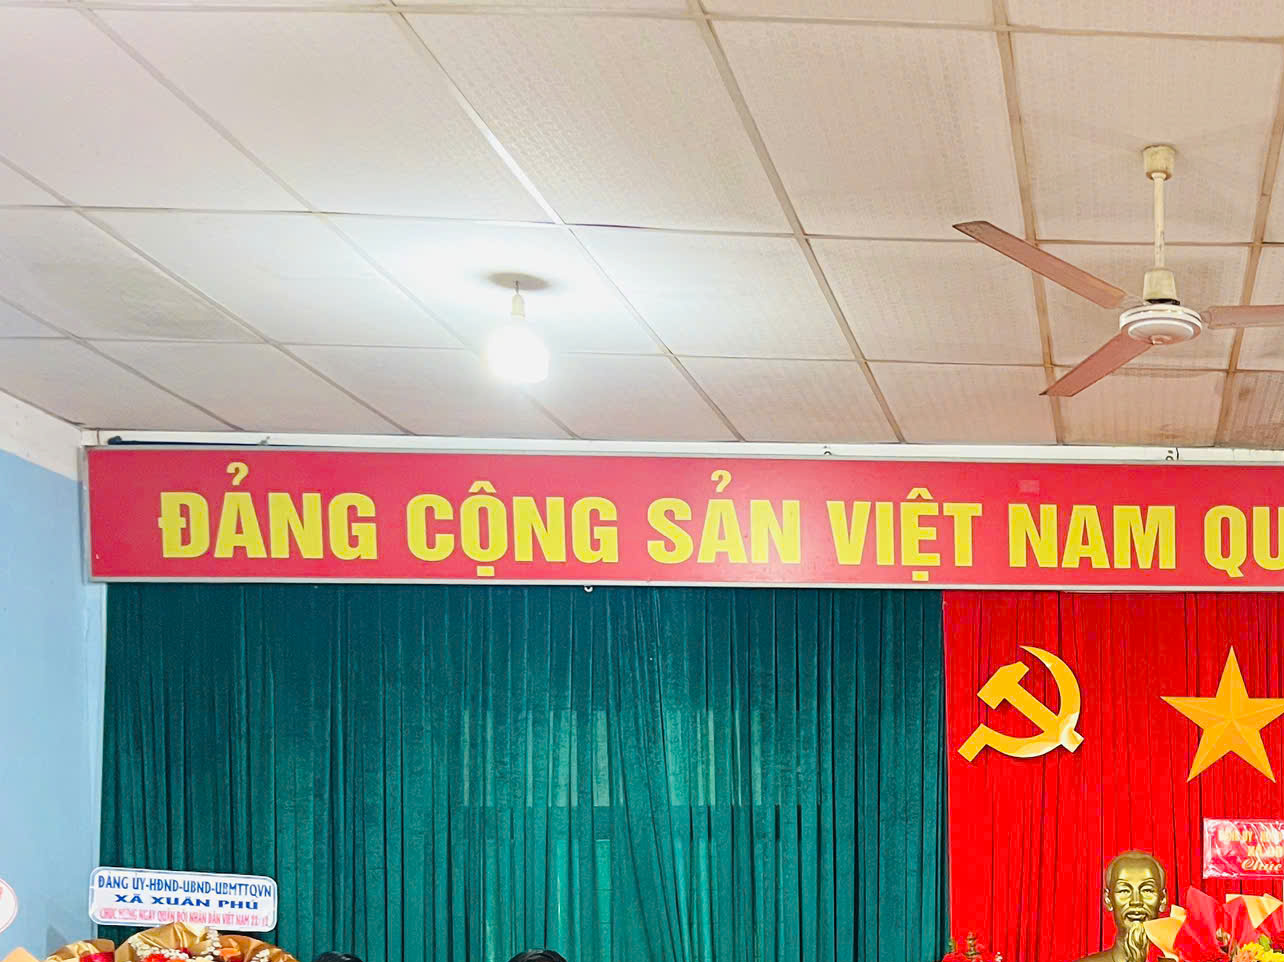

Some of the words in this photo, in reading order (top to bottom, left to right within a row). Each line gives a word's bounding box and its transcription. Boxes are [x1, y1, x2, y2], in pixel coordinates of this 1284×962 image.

[158, 461, 378, 560] ĐẢNG
[406, 480, 619, 577] CỘNG
[646, 469, 801, 565] SẢN
[826, 487, 983, 582] VIỆT
[1008, 502, 1176, 570] NAM
[115, 893, 143, 904] XÃ
